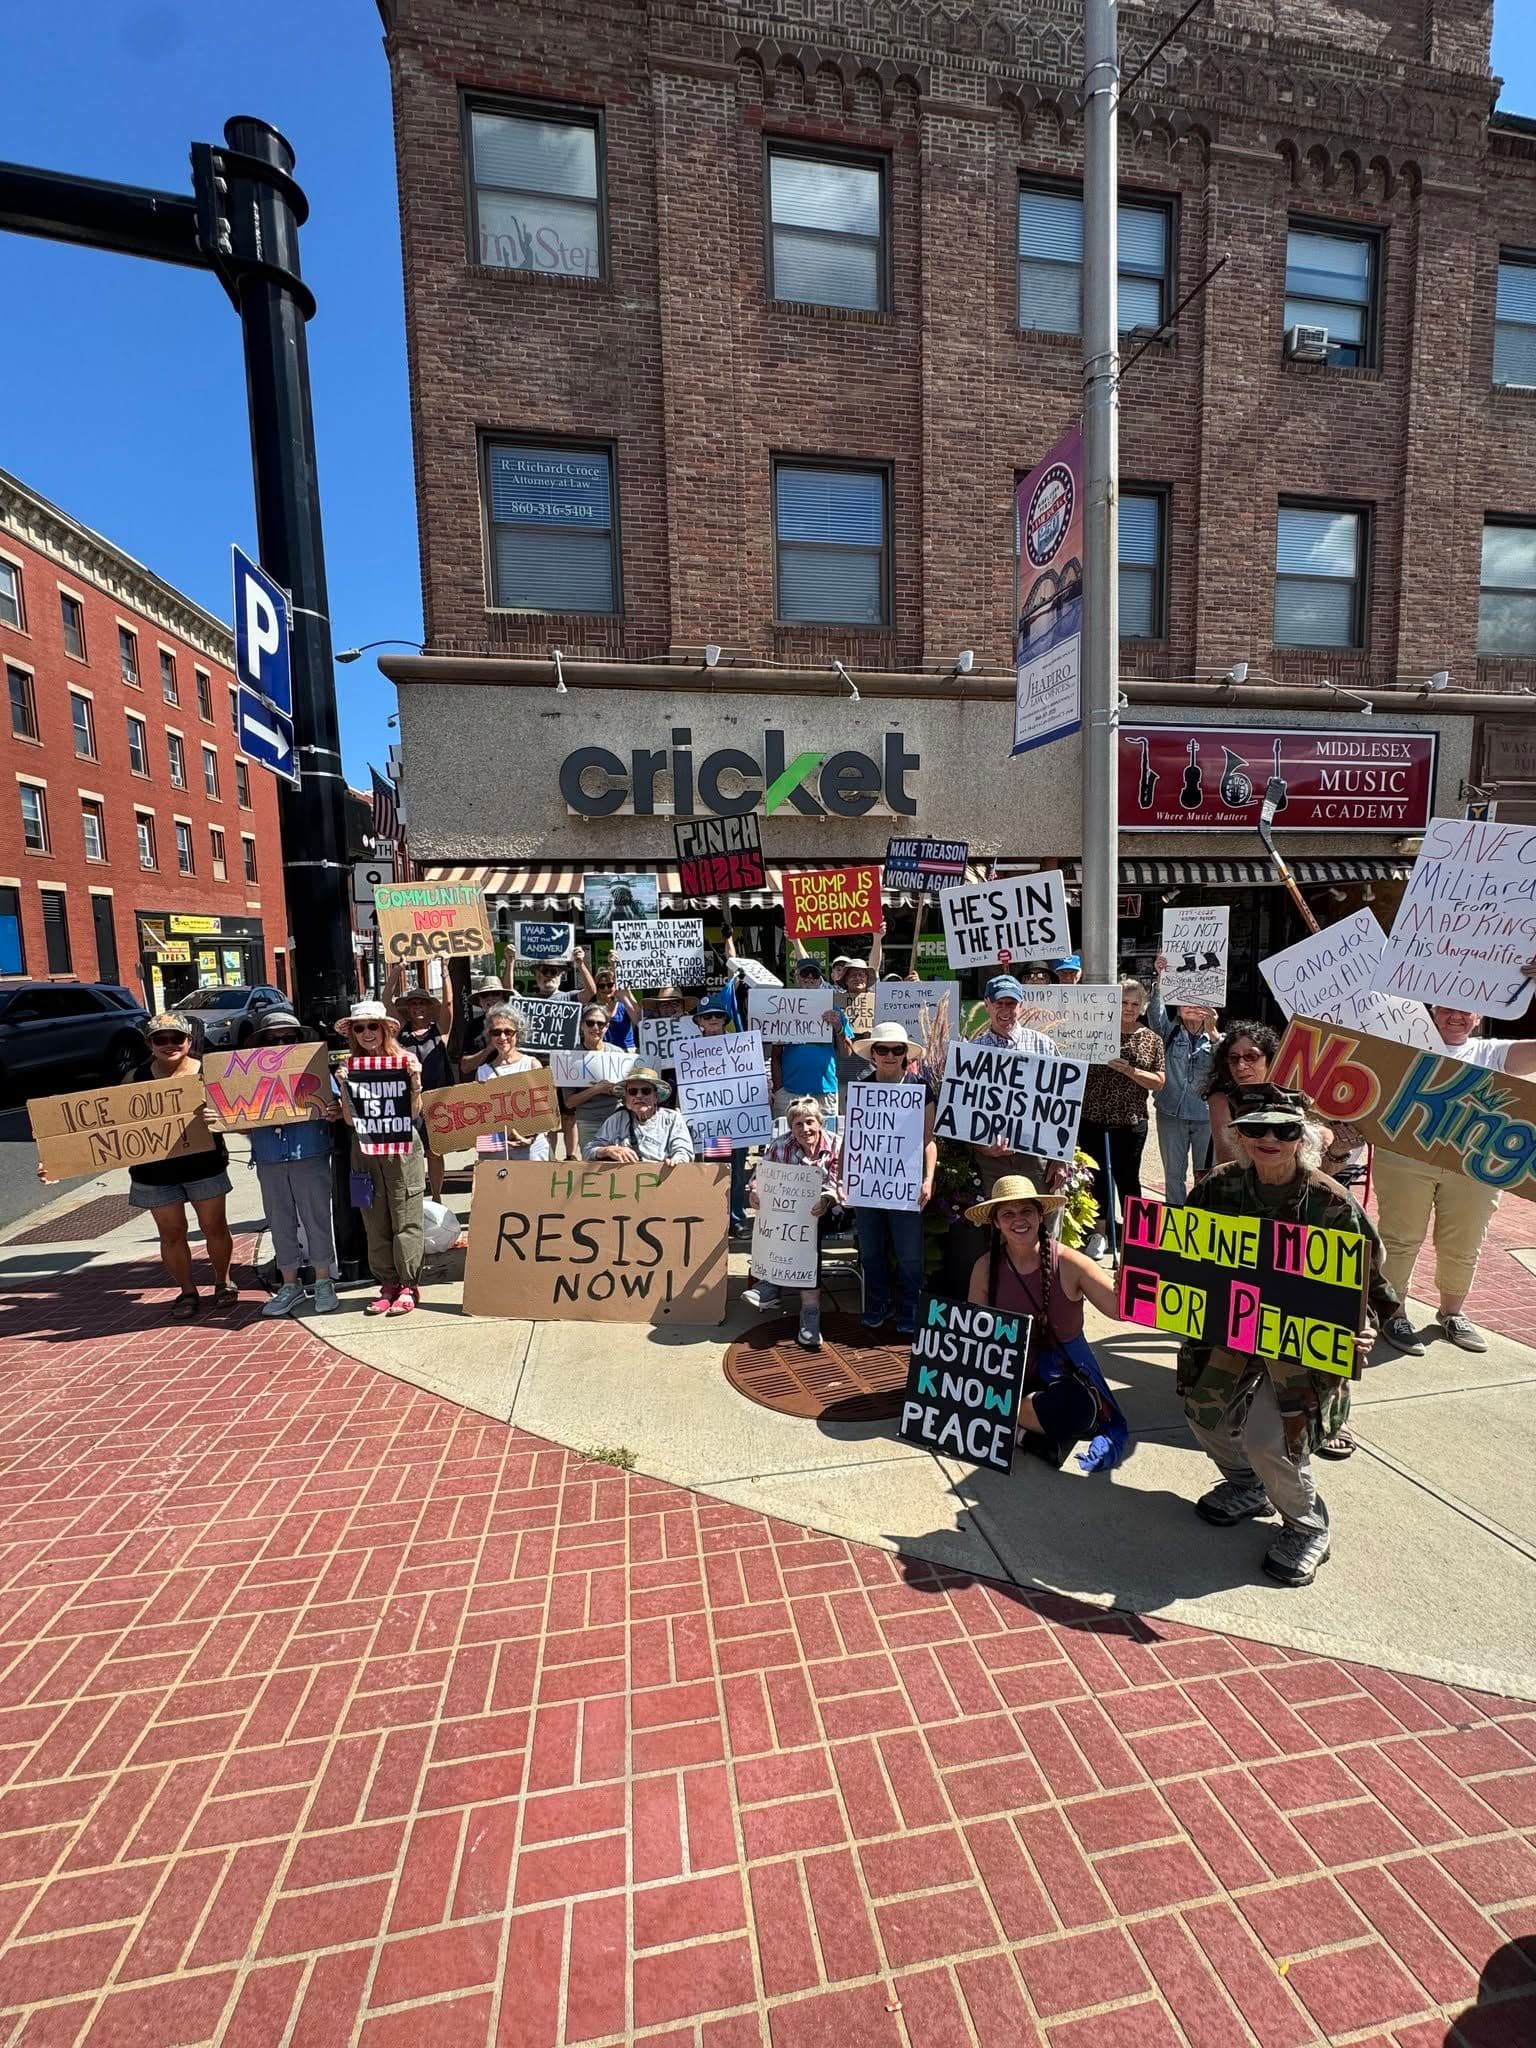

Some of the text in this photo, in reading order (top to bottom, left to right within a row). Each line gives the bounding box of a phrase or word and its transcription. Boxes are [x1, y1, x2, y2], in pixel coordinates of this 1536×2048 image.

[517, 460, 563, 474] Richard
[566, 464, 600, 477] Croce
[511, 475, 555, 489] Attorney
[570, 479, 591, 489] Law
[245, 573, 279, 680] P
[1316, 741, 1411, 759] MIDDLESEX
[559, 728, 920, 817] cricket
[1319, 769, 1406, 793] MUSIC
[1156, 811, 1248, 822] Where Music Matters
[1311, 803, 1407, 819] ACADEMY
[890, 841, 967, 861] MAKE TREASON
[1419, 821, 1523, 863] SAVE
[789, 871, 873, 895] TRUMP IS
[886, 870, 962, 891] WRONG AGAIN
[375, 886, 482, 910] COMMUNITY
[795, 890, 869, 913] ROBBING
[949, 882, 1053, 926] HE'S IN
[413, 909, 456, 931] NOT
[678, 919, 702, 929] WANT
[795, 911, 873, 933] AMERICA
[1400, 903, 1471, 933] MAD
[525, 926, 545, 935] WAR
[645, 931, 651, 940] A
[954, 917, 1056, 955] THE FILES
[1173, 923, 1223, 937] DO NOT
[390, 928, 484, 957] CAGES
[526, 944, 563, 953] ANSWER!
[640, 940, 676, 950] BILLION
[917, 941, 946, 956] FRE
[1164, 940, 1190, 953] TREAD
[1405, 933, 1432, 958] his
[616, 958, 672, 968] AFFORDABLE
[706, 974, 729, 986] cric
[766, 995, 808, 1015] SAVE
[846, 994, 867, 1008] DUE
[891, 989, 934, 999] FOR THE
[1022, 989, 1053, 1002] RUMP
[1284, 974, 1344, 1015] Valued
[513, 1000, 578, 1019] DEMOCRACY
[1375, 1000, 1419, 1031] the
[524, 1014, 564, 1032] IES IN
[655, 1020, 681, 1038] BE
[522, 1031, 565, 1047] LENCE
[224, 1045, 298, 1078] NO
[680, 1043, 723, 1061] Silence
[680, 1056, 754, 1080] Protect You
[956, 1047, 1081, 1096] WAKE UP
[206, 1072, 327, 1124] WAR
[350, 1081, 406, 1099] TRUMP
[852, 1086, 922, 1109] TERROR
[61, 1088, 184, 1134] ICE OUT
[364, 1099, 395, 1117] IS A
[428, 1085, 553, 1133] STOP ICE
[946, 1078, 1081, 1127] THIS IS NOT
[1267, 1021, 1536, 1189] No King
[354, 1116, 412, 1134] TRAITOR
[851, 1107, 895, 1130] RUIN
[934, 1105, 957, 1136] A
[88, 1117, 190, 1167] NOW!
[850, 1130, 905, 1154] UNFIT
[848, 1152, 906, 1178] MANIA
[551, 1170, 661, 1202] HELP
[847, 1174, 917, 1201] PLAGUE
[772, 1197, 797, 1210] NOT
[494, 1212, 704, 1267] RESIST
[781, 1223, 810, 1242] ICE
[769, 1251, 793, 1263] Please
[1276, 1224, 1362, 1286] MOM
[553, 1269, 673, 1314] NOW!
[928, 1299, 1019, 1344] KNOW
[1123, 1271, 1348, 1367] FOR PEACE
[912, 1328, 1018, 1379] JUSTICE
[918, 1366, 1012, 1416] KNOW
[901, 1401, 1011, 1467] PEACE
